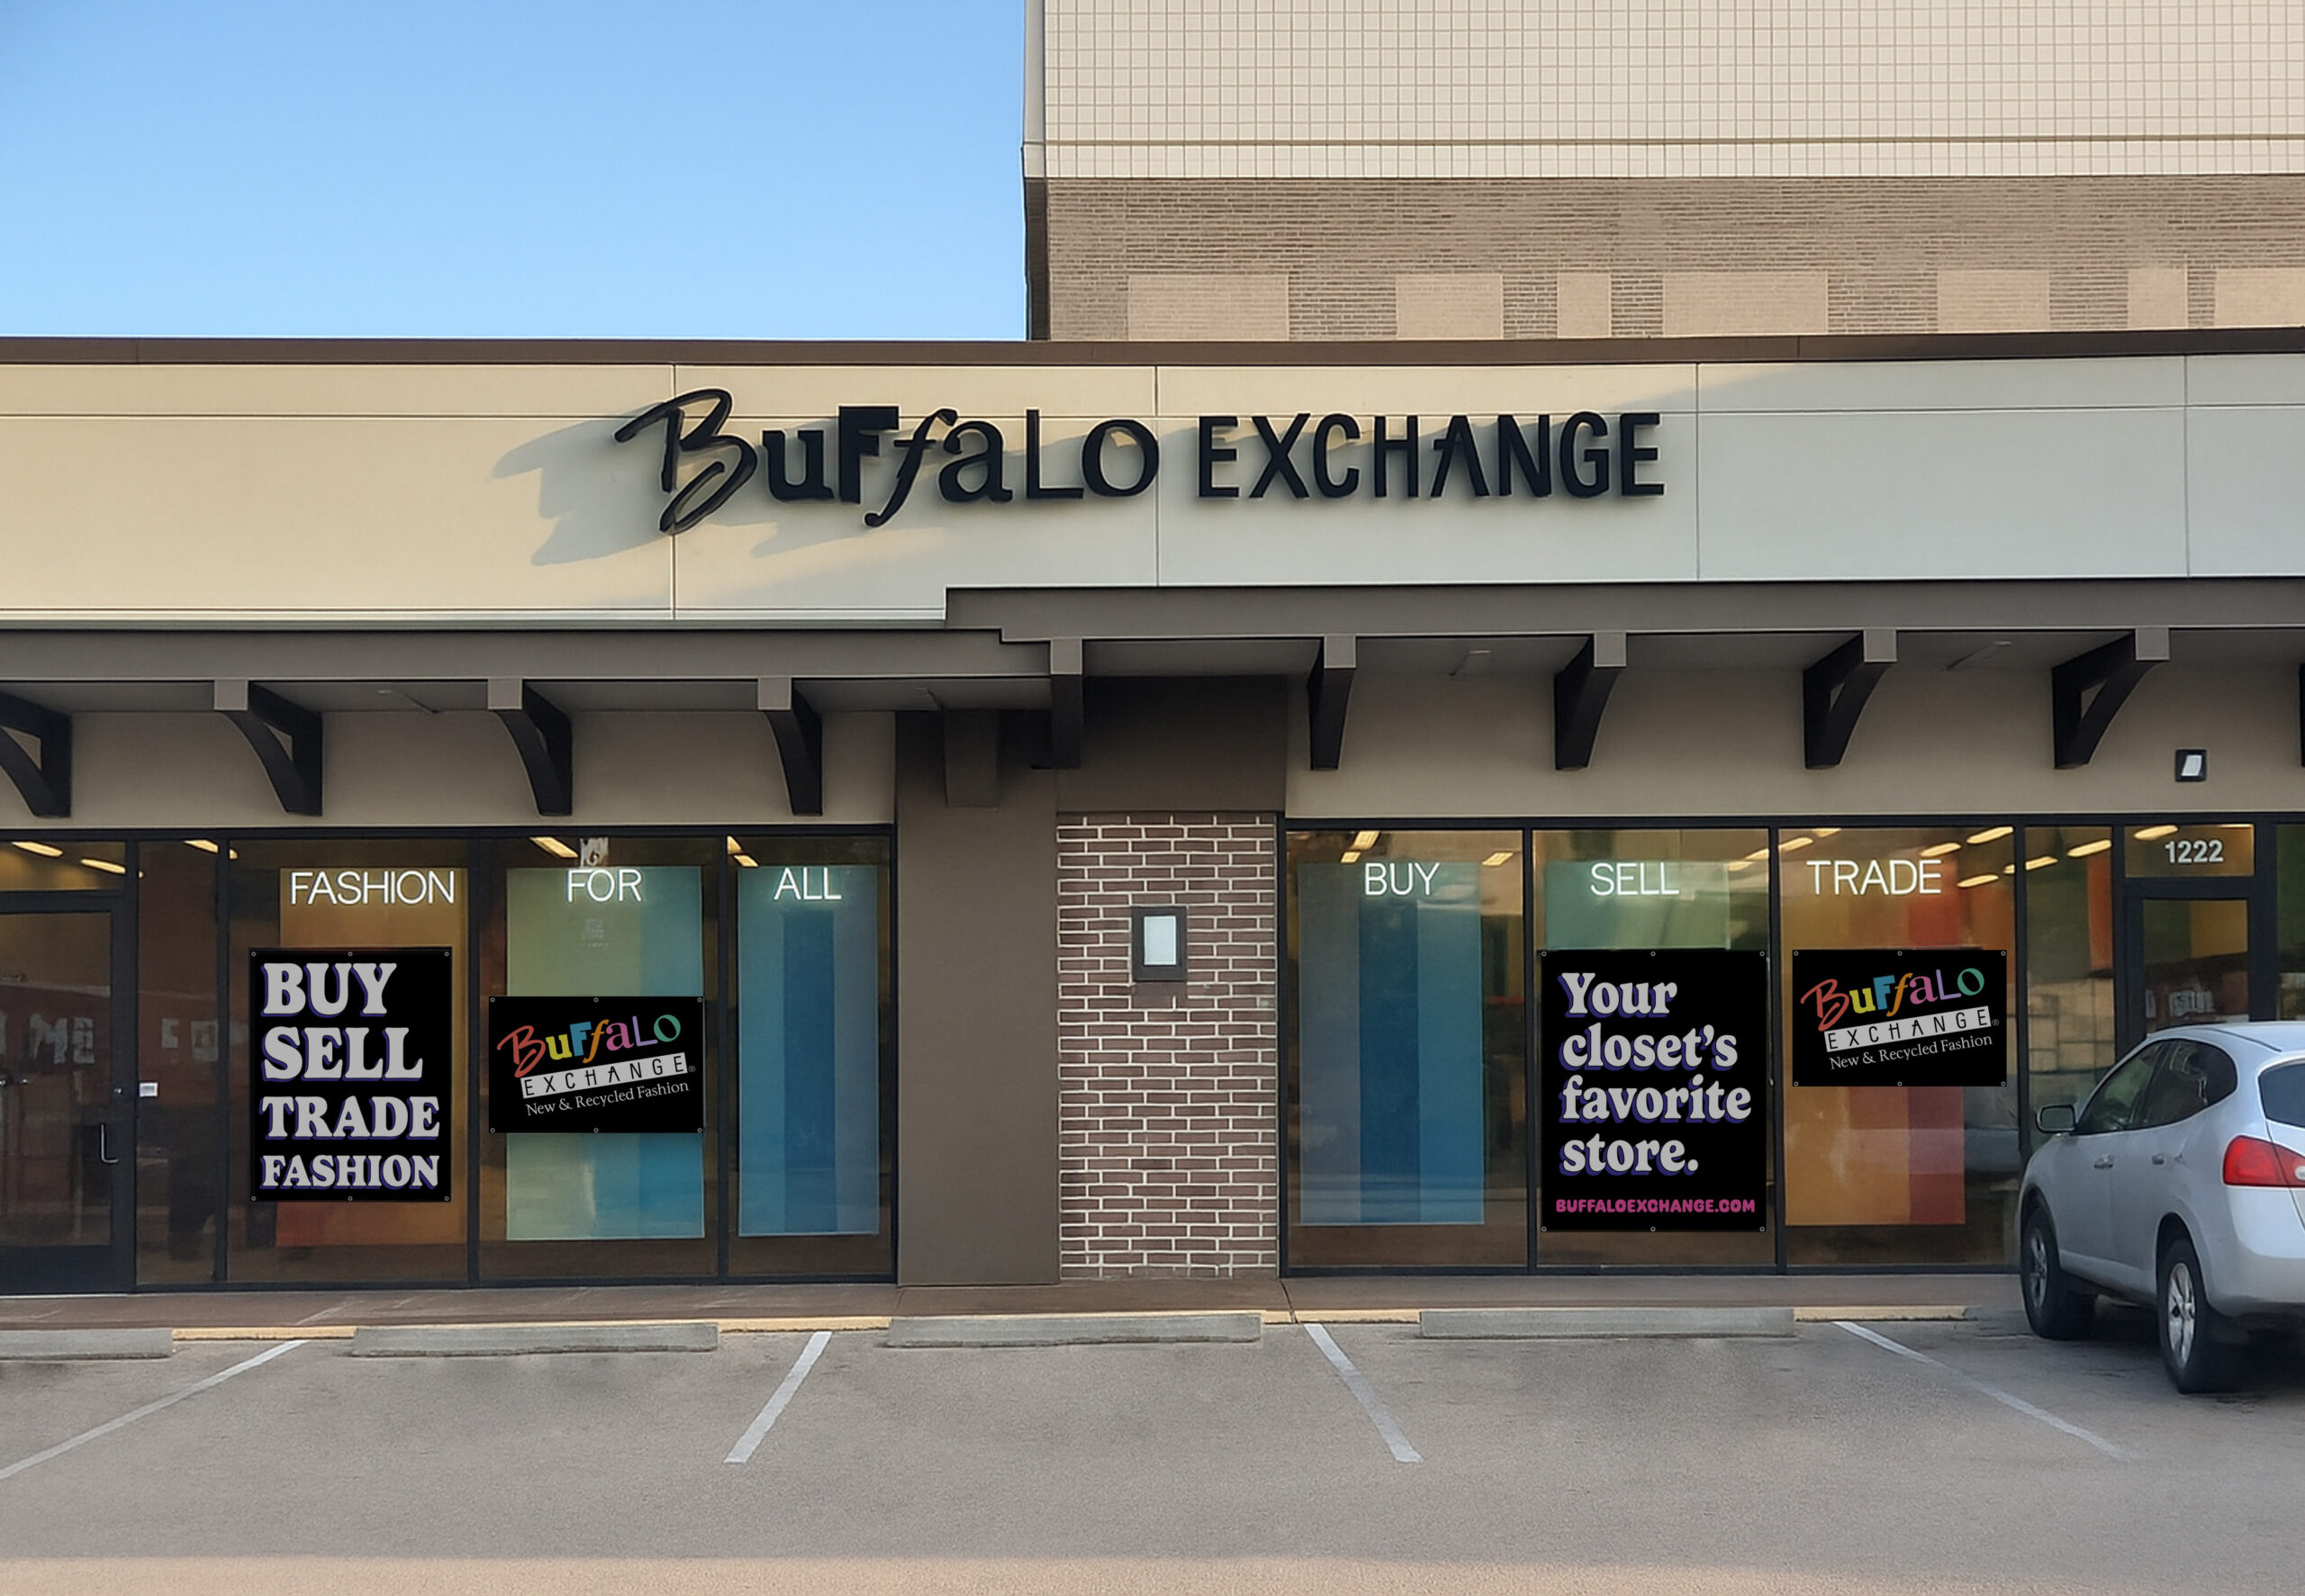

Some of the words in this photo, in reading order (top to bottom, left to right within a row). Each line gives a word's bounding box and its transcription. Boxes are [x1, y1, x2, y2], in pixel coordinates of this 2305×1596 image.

[1197, 410, 1666, 500] EXCHANGE
[2165, 840, 2224, 863] 1222
[291, 870, 455, 905] FASHION
[567, 869, 642, 902] FOR
[773, 867, 842, 900] ALL
[1364, 861, 1441, 896] BUY
[1590, 861, 1680, 897] SELL
[1806, 859, 1942, 895] TRADE
[260, 963, 397, 1018] BUY
[1558, 972, 1677, 1018] Your
[261, 1026, 423, 1082] SELL
[1559, 1022, 1739, 1071] closet's
[1830, 1055, 1859, 1070] New
[1862, 1051, 1877, 1065] &
[1879, 1041, 1939, 1062] Recycled
[1941, 1035, 1993, 1053] Fashion
[526, 1101, 556, 1116] New
[558, 1097, 574, 1111] &
[575, 1087, 635, 1108] Recycled
[637, 1081, 690, 1099] Fashion
[1559, 1073, 1751, 1123] favorite
[259, 1096, 440, 1140] TRADE
[259, 1155, 440, 1190] FASHION
[1559, 1132, 1699, 1177] store.
[1556, 1198, 1756, 1213] BUFFALOEXCHANGE.COM
